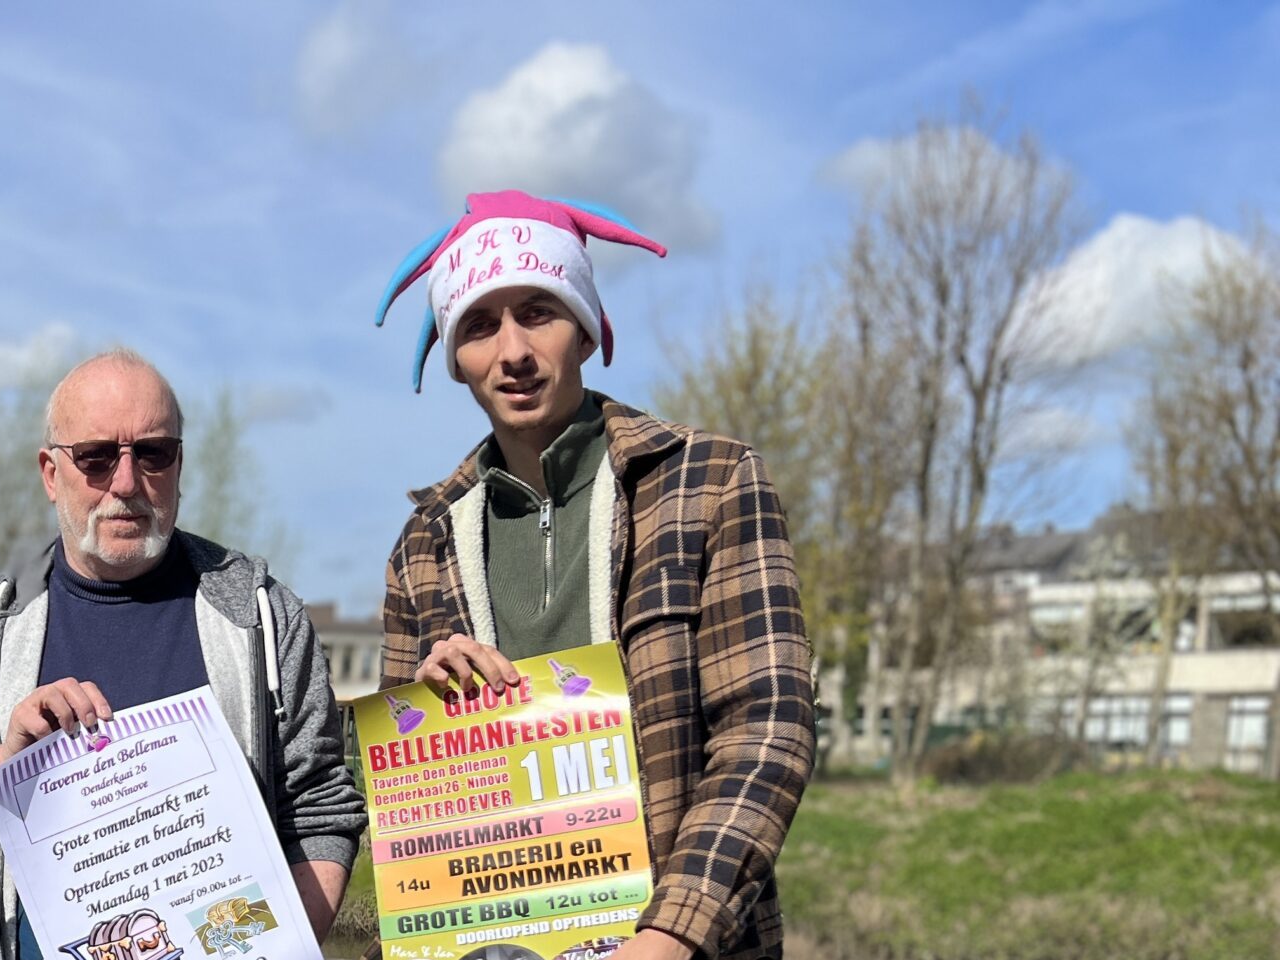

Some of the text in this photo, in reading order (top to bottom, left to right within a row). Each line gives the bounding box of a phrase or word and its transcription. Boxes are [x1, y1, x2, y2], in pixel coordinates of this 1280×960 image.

[516, 251, 565, 280] Dest
[368, 705, 624, 773] BELLEMANFEESTEN
[39, 733, 179, 796] Taverne den Belleman
[80, 762, 147, 798] Denderkaai 26
[372, 755, 507, 790] Taverne Den Belleman
[520, 734, 631, 801] 1 MEI
[90, 780, 149, 810] 9400 Ninove
[374, 784, 443, 807] Denderkaai
[444, 781, 459, 795] 26
[467, 772, 509, 789] Ninove
[377, 789, 513, 828] RECHTEROEVER
[52, 783, 210, 861] Grote rommelmarkt met
[73, 808, 206, 873] animatie en braderij
[390, 806, 621, 858] ROMMELMARKT 9-22u
[64, 826, 233, 902] Optredens en avondmarkt
[448, 837, 603, 877] BRADERIJ en
[461, 852, 632, 897] AVONDMARKT
[86, 853, 225, 918] Maandag 1 mei 2023
[170, 889, 195, 908] vanaf
[196, 881, 227, 899] 09.00u
[228, 875, 242, 886] tot
[396, 878, 431, 894] 14u
[397, 908, 474, 934] GROTE
[479, 898, 530, 922] BBQ
[545, 893, 582, 910] 12u
[588, 888, 618, 903] tot
[456, 907, 639, 946] DOORLOPEND OPTREDENS
[389, 944, 455, 958] Marc & Jan
